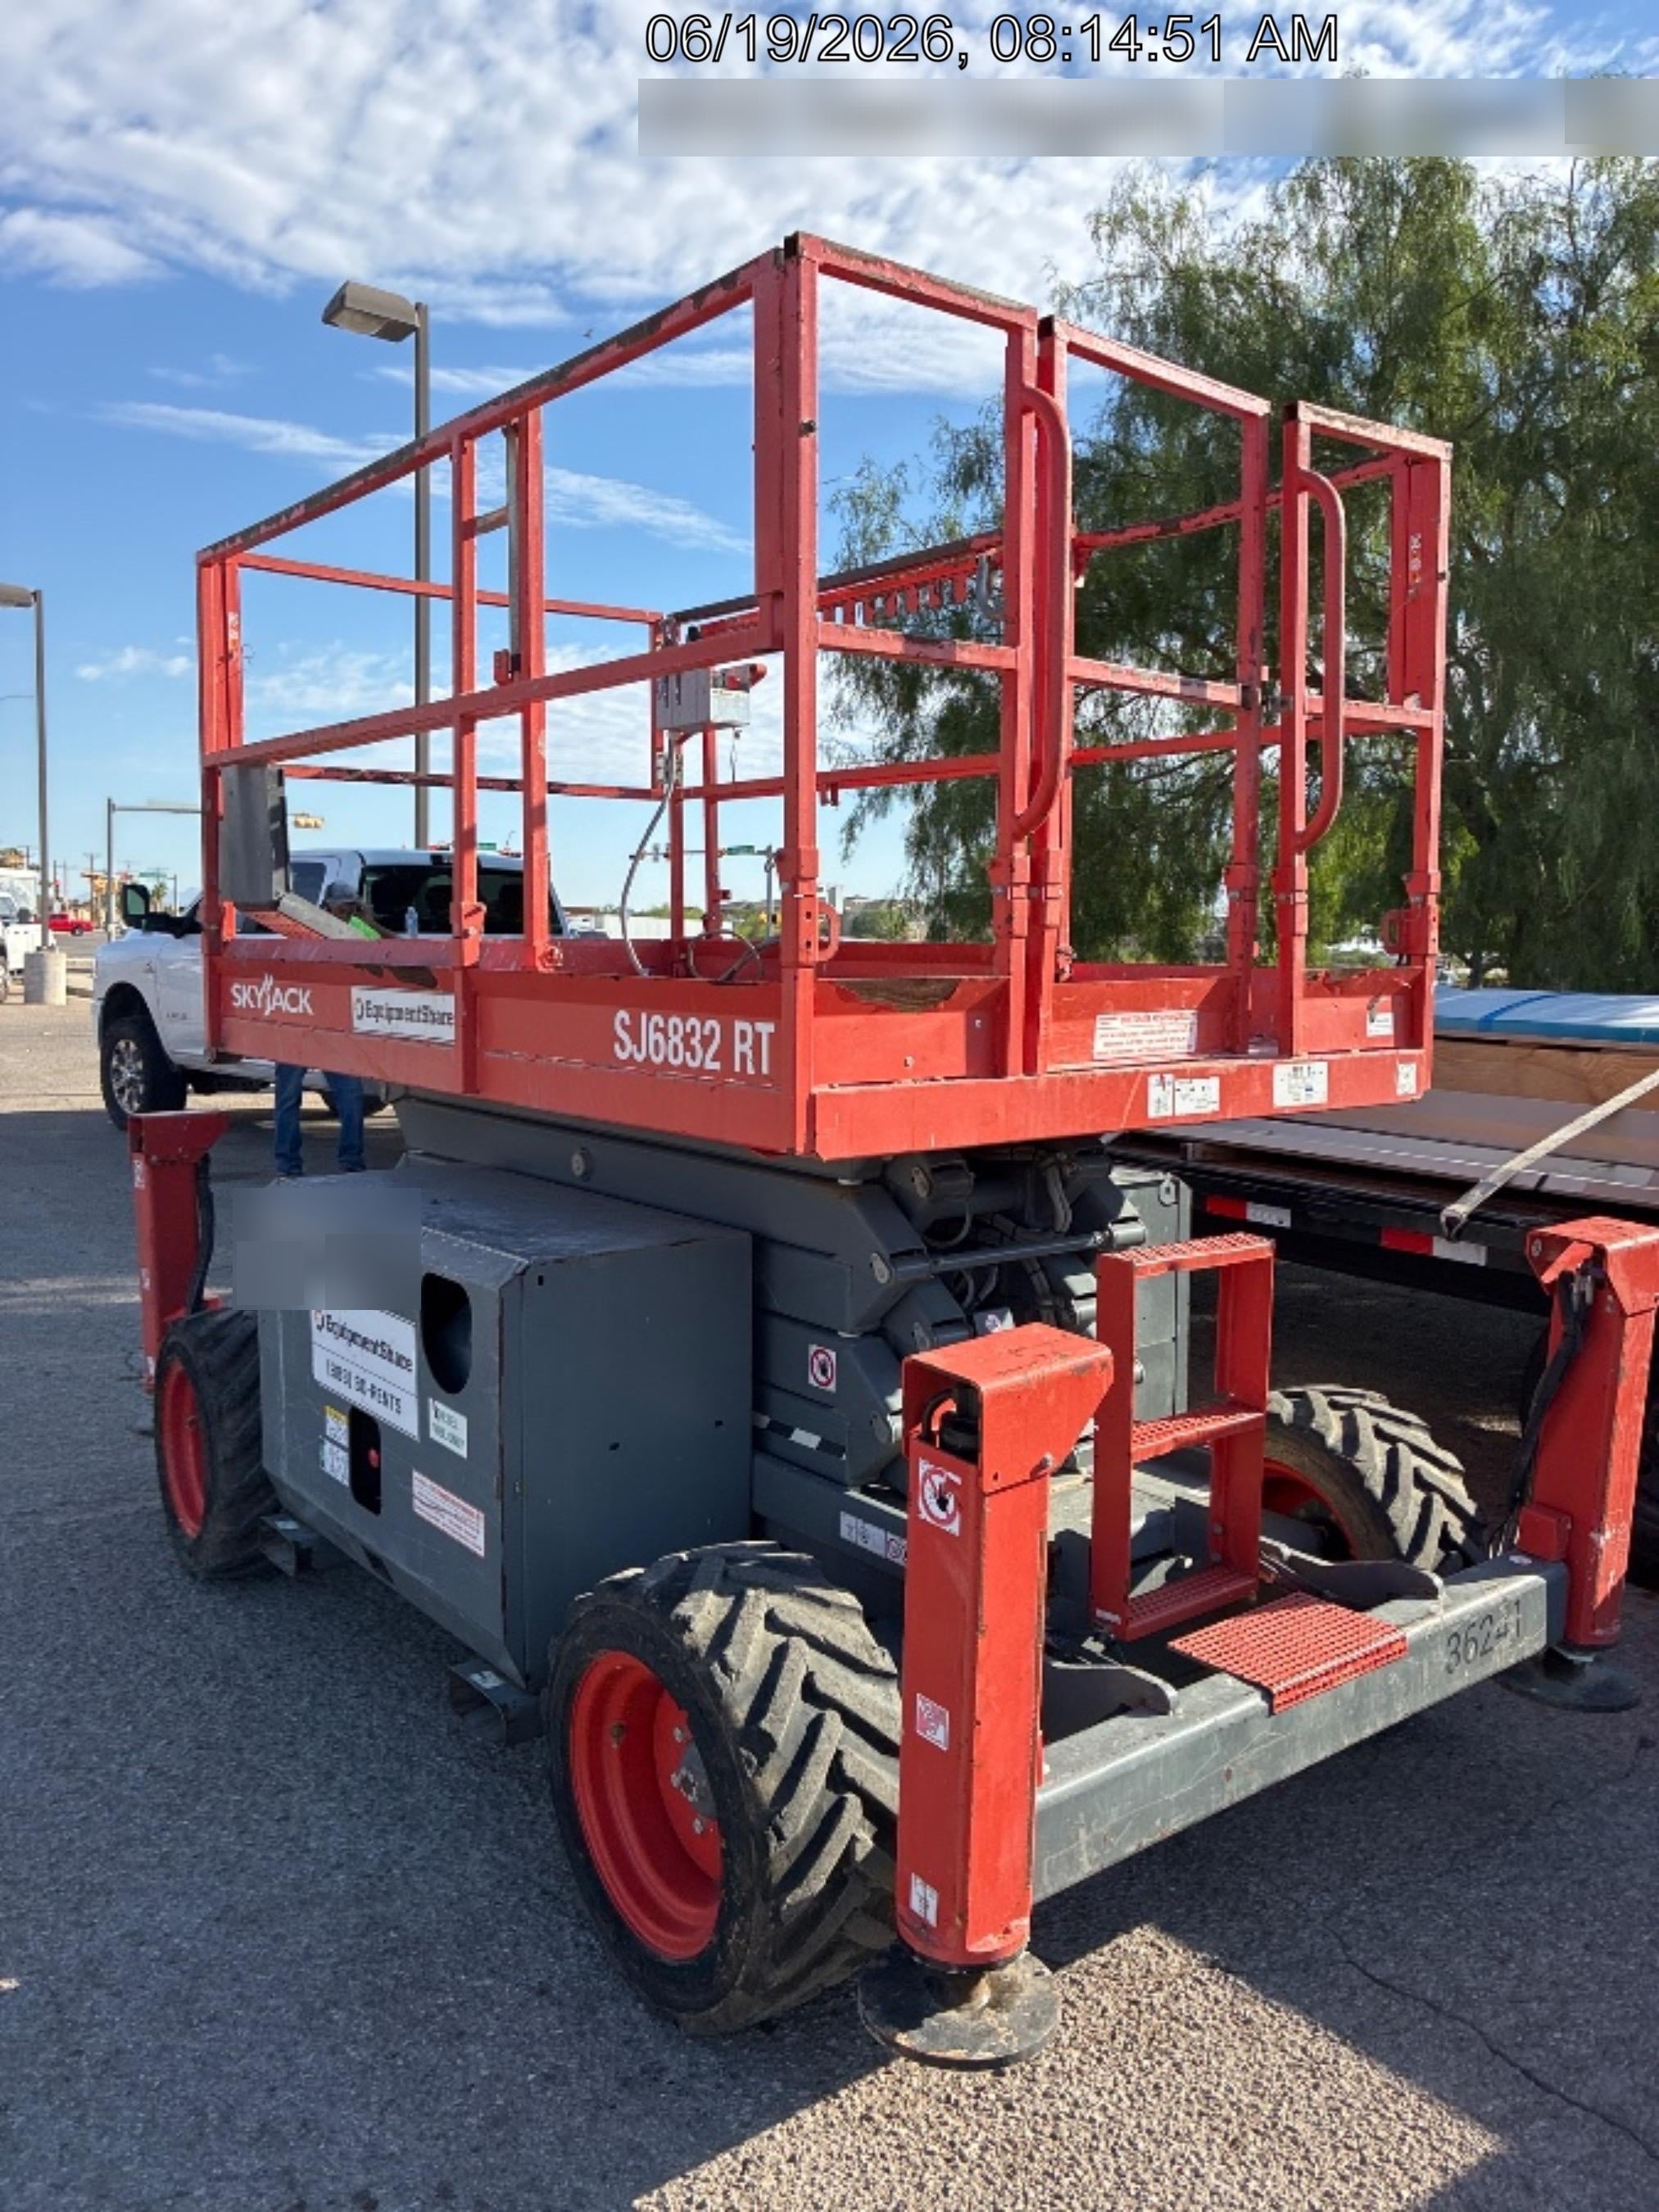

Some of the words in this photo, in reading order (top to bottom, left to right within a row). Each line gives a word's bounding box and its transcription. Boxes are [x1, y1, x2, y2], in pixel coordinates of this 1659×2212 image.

[230, 972, 315, 1016] SKYJACK
[365, 999, 454, 1026] EquipmentShare
[614, 1009, 722, 1072] SJ6832
[733, 1020, 776, 1075] RT
[325, 1313, 414, 1372] EquipmentShare
[1444, 1598, 1521, 1675] 36241
